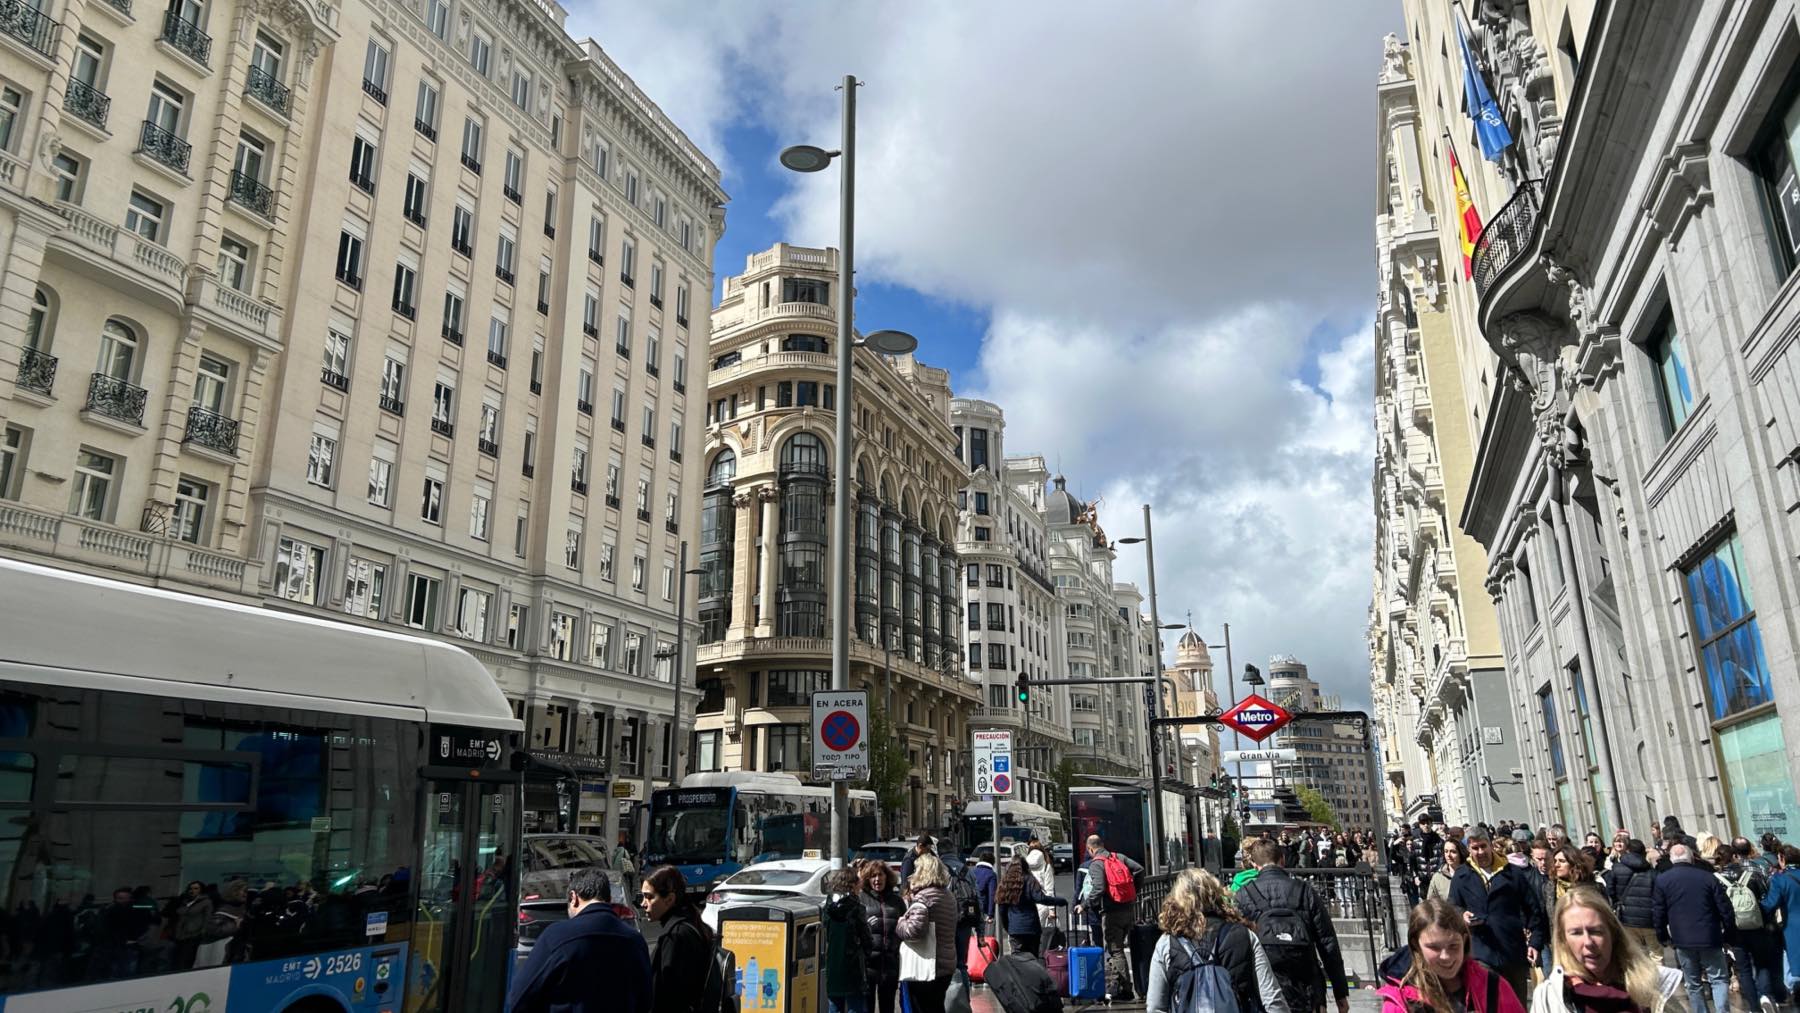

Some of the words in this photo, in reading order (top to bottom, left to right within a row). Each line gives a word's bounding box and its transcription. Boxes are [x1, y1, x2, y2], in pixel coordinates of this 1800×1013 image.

[816, 700, 829, 708] EN
[833, 699, 864, 707] ACERA
[1240, 711, 1273, 723] Metro
[469, 739, 485, 749] EMT
[456, 748, 485, 758] MADRID
[821, 753, 842, 761] TODO
[1240, 752, 1263, 760] Gran
[666, 794, 672, 806] 1
[282, 961, 301, 972] EMT
[325, 953, 362, 976] 2526
[265, 971, 302, 985] MADRID
